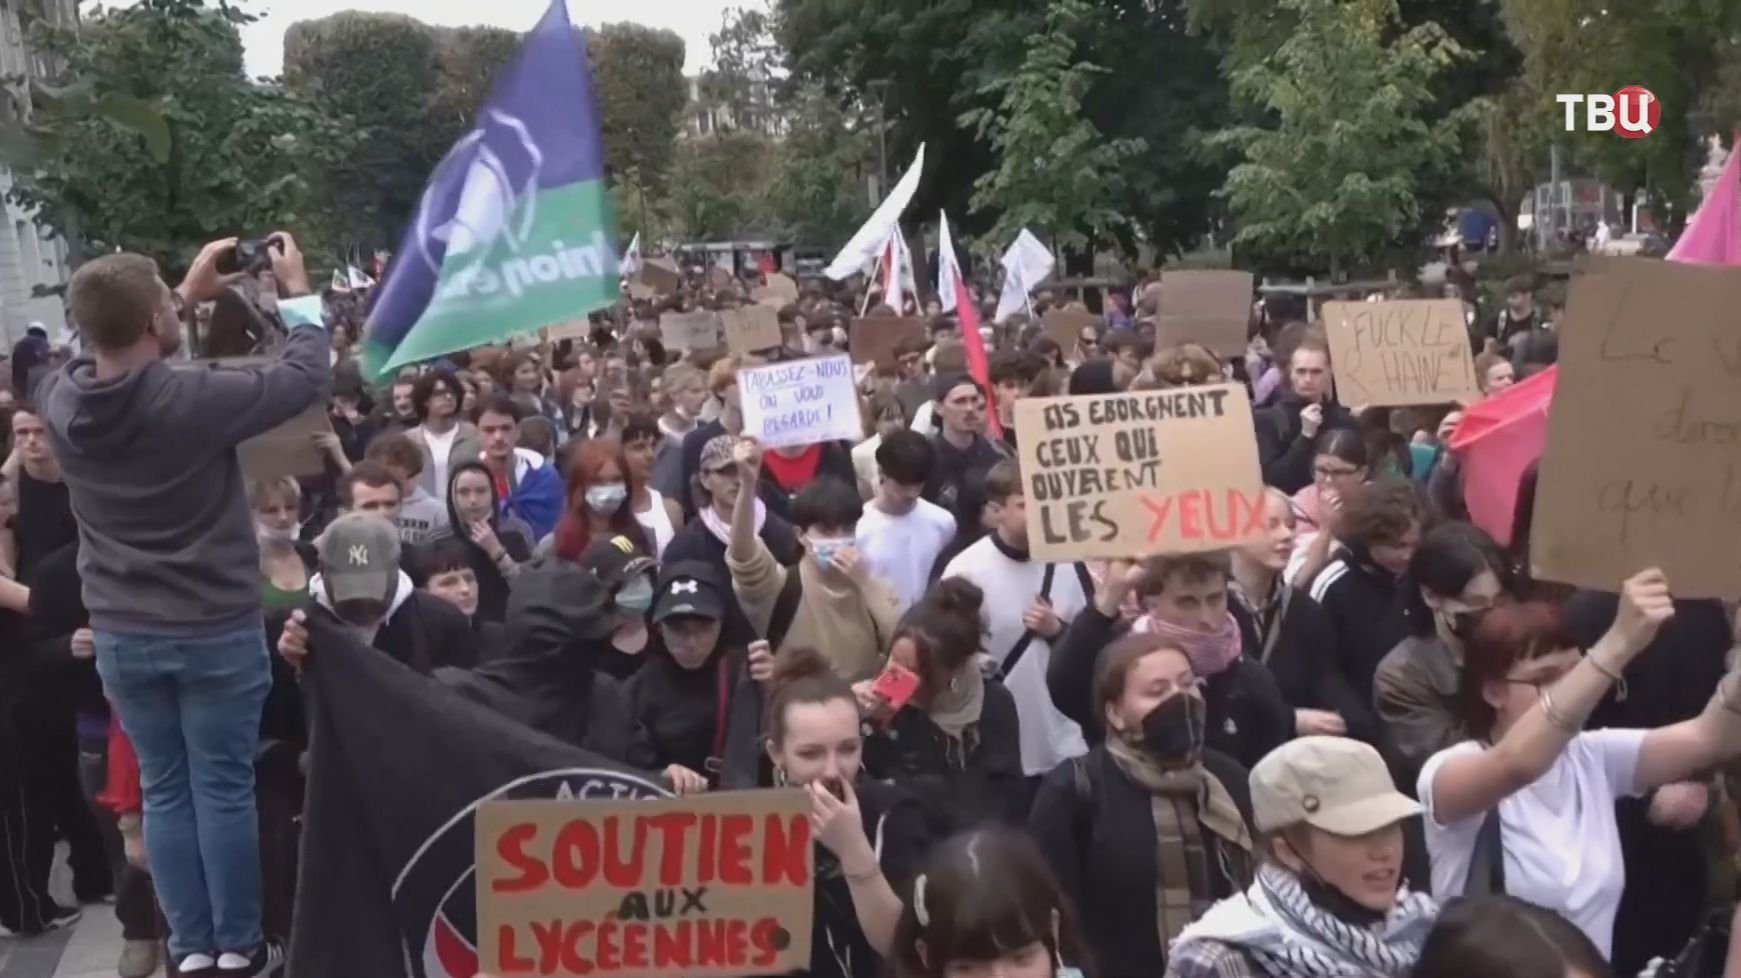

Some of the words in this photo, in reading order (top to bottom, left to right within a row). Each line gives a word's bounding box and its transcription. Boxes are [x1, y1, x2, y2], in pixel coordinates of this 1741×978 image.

[1088, 388, 1229, 426] EBORGNENT
[1036, 434, 1100, 468] CEUX
[1114, 427, 1160, 463] QUI
[1041, 500, 1119, 545] LES
[1138, 488, 1265, 542] YEUX
[491, 811, 811, 893] SOUTIEN
[616, 886, 709, 922] AUX
